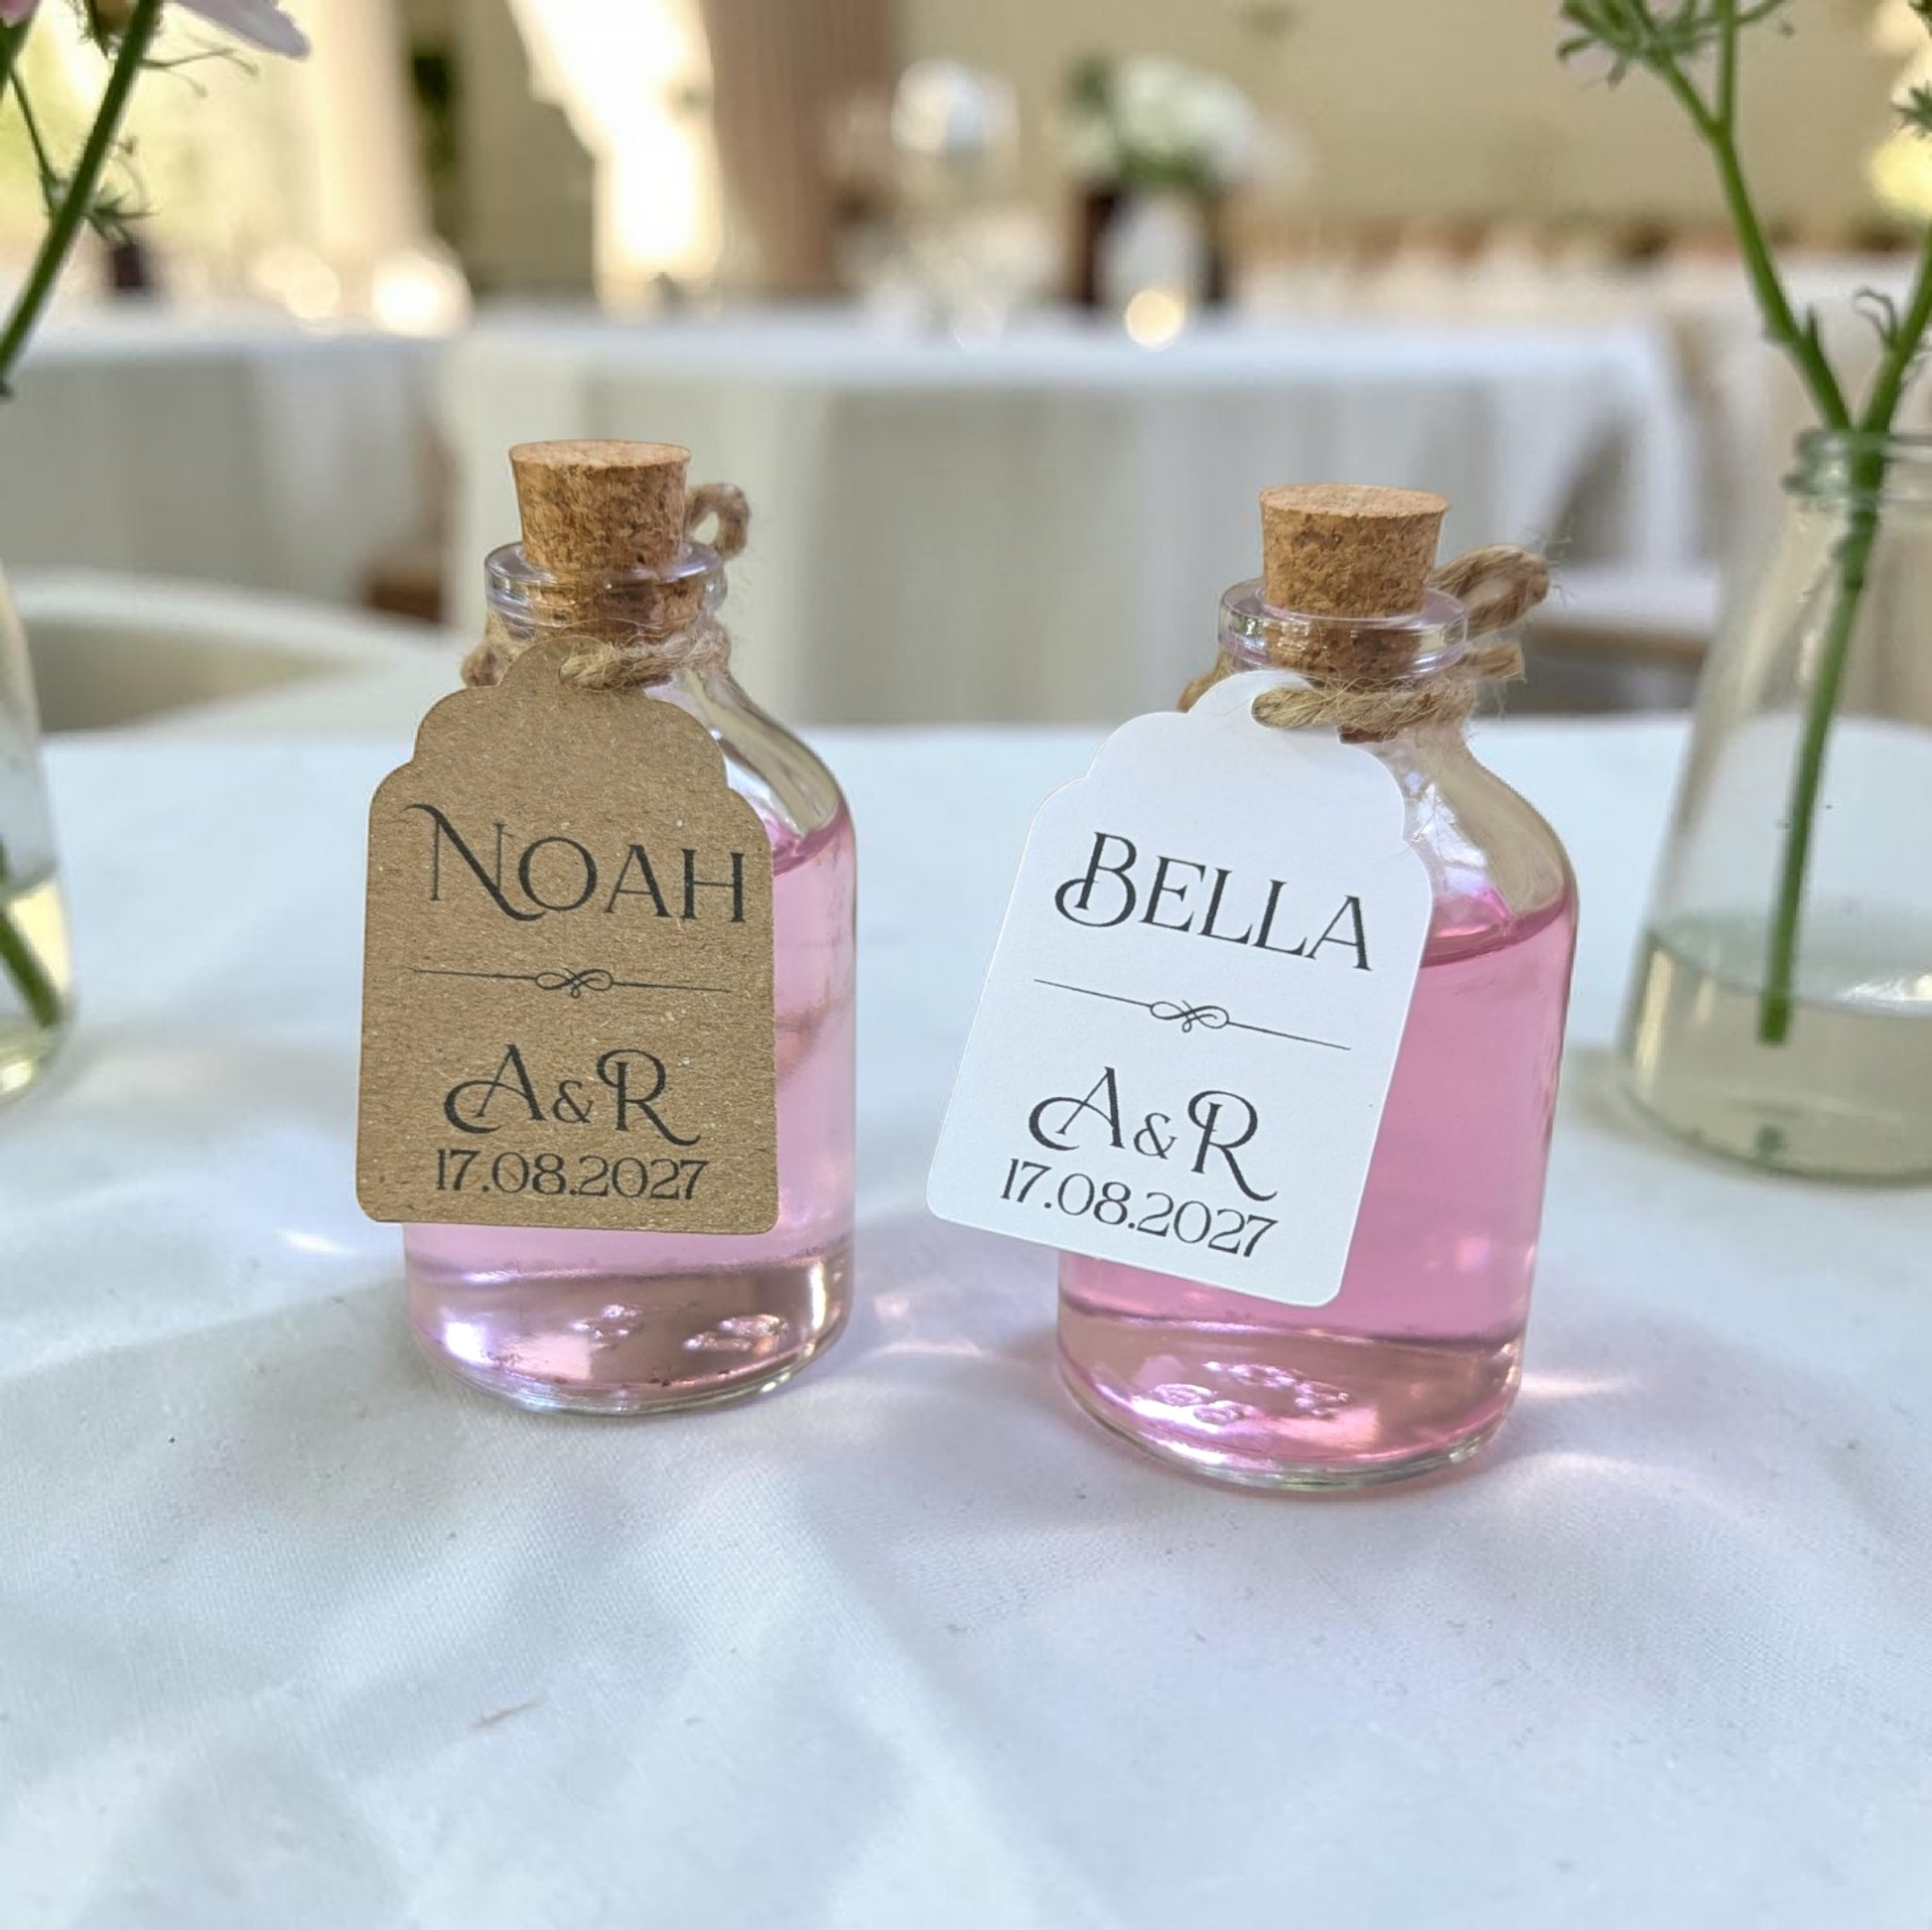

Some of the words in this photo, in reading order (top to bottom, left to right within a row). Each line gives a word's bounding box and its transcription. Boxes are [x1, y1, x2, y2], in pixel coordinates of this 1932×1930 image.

[403, 802, 747, 923] NOAH
[1053, 831, 1373, 971] BELLA
[443, 1043, 702, 1147] A&R
[1028, 1066, 1279, 1202] A&R
[436, 1148, 710, 1201] 17.08.2027
[1000, 1158, 1280, 1258] 17.08.2027
